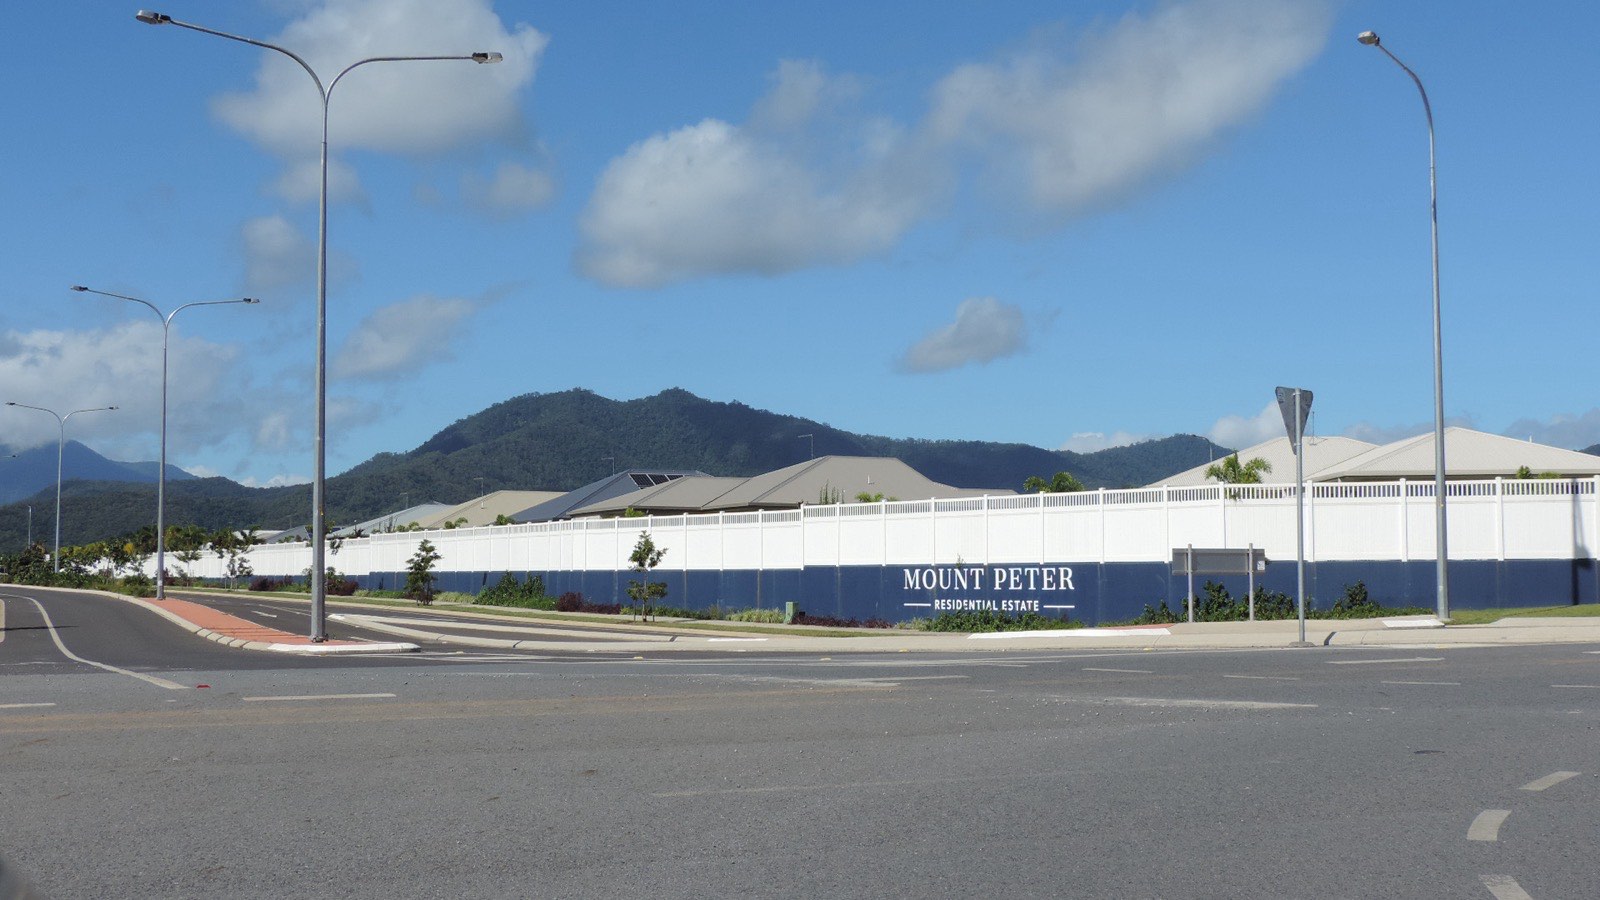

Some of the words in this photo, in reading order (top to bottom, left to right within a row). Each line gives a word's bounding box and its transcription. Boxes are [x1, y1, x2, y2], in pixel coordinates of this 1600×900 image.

[903, 568, 985, 590] MOUNT
[993, 567, 1075, 591] PETER
[934, 599, 998, 611] RESIDENTIAL
[1001, 600, 1039, 611] ESTATE
